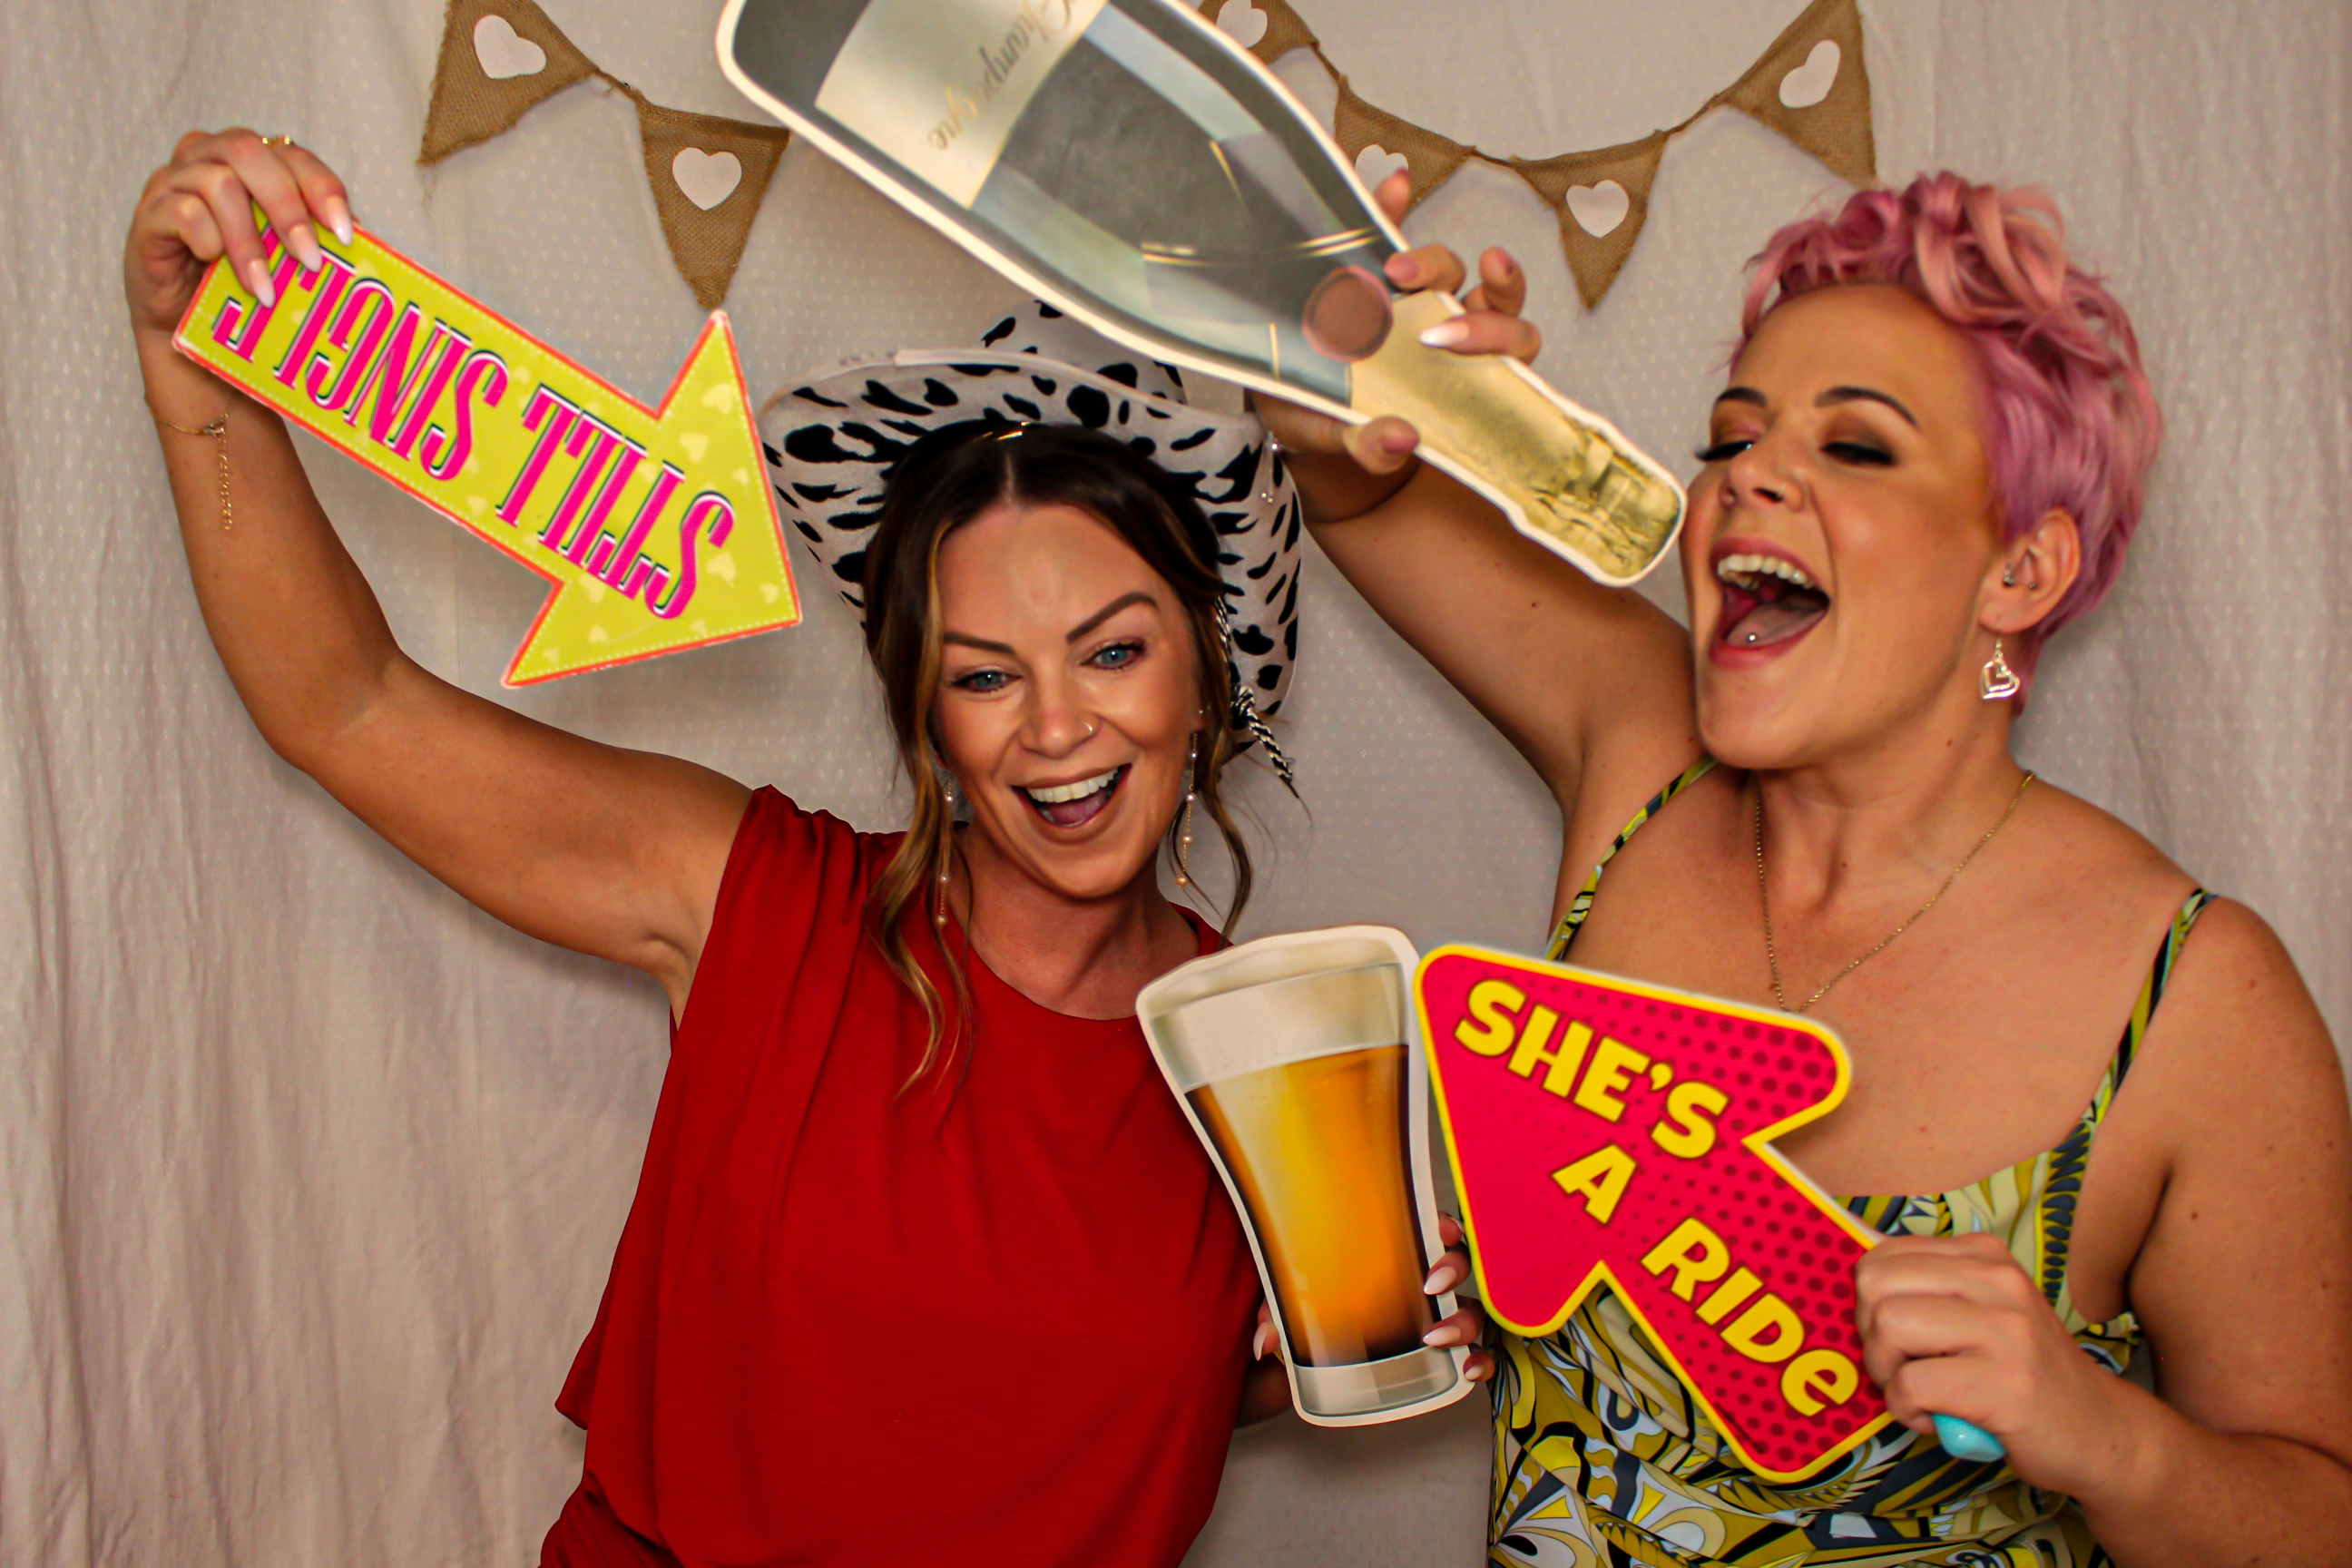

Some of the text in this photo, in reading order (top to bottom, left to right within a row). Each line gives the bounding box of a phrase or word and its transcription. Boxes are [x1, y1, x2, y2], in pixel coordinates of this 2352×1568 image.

[496, 383, 735, 619] STILL
[1454, 978, 1730, 1159] SHE'S
[1552, 1143, 1637, 1225] A
